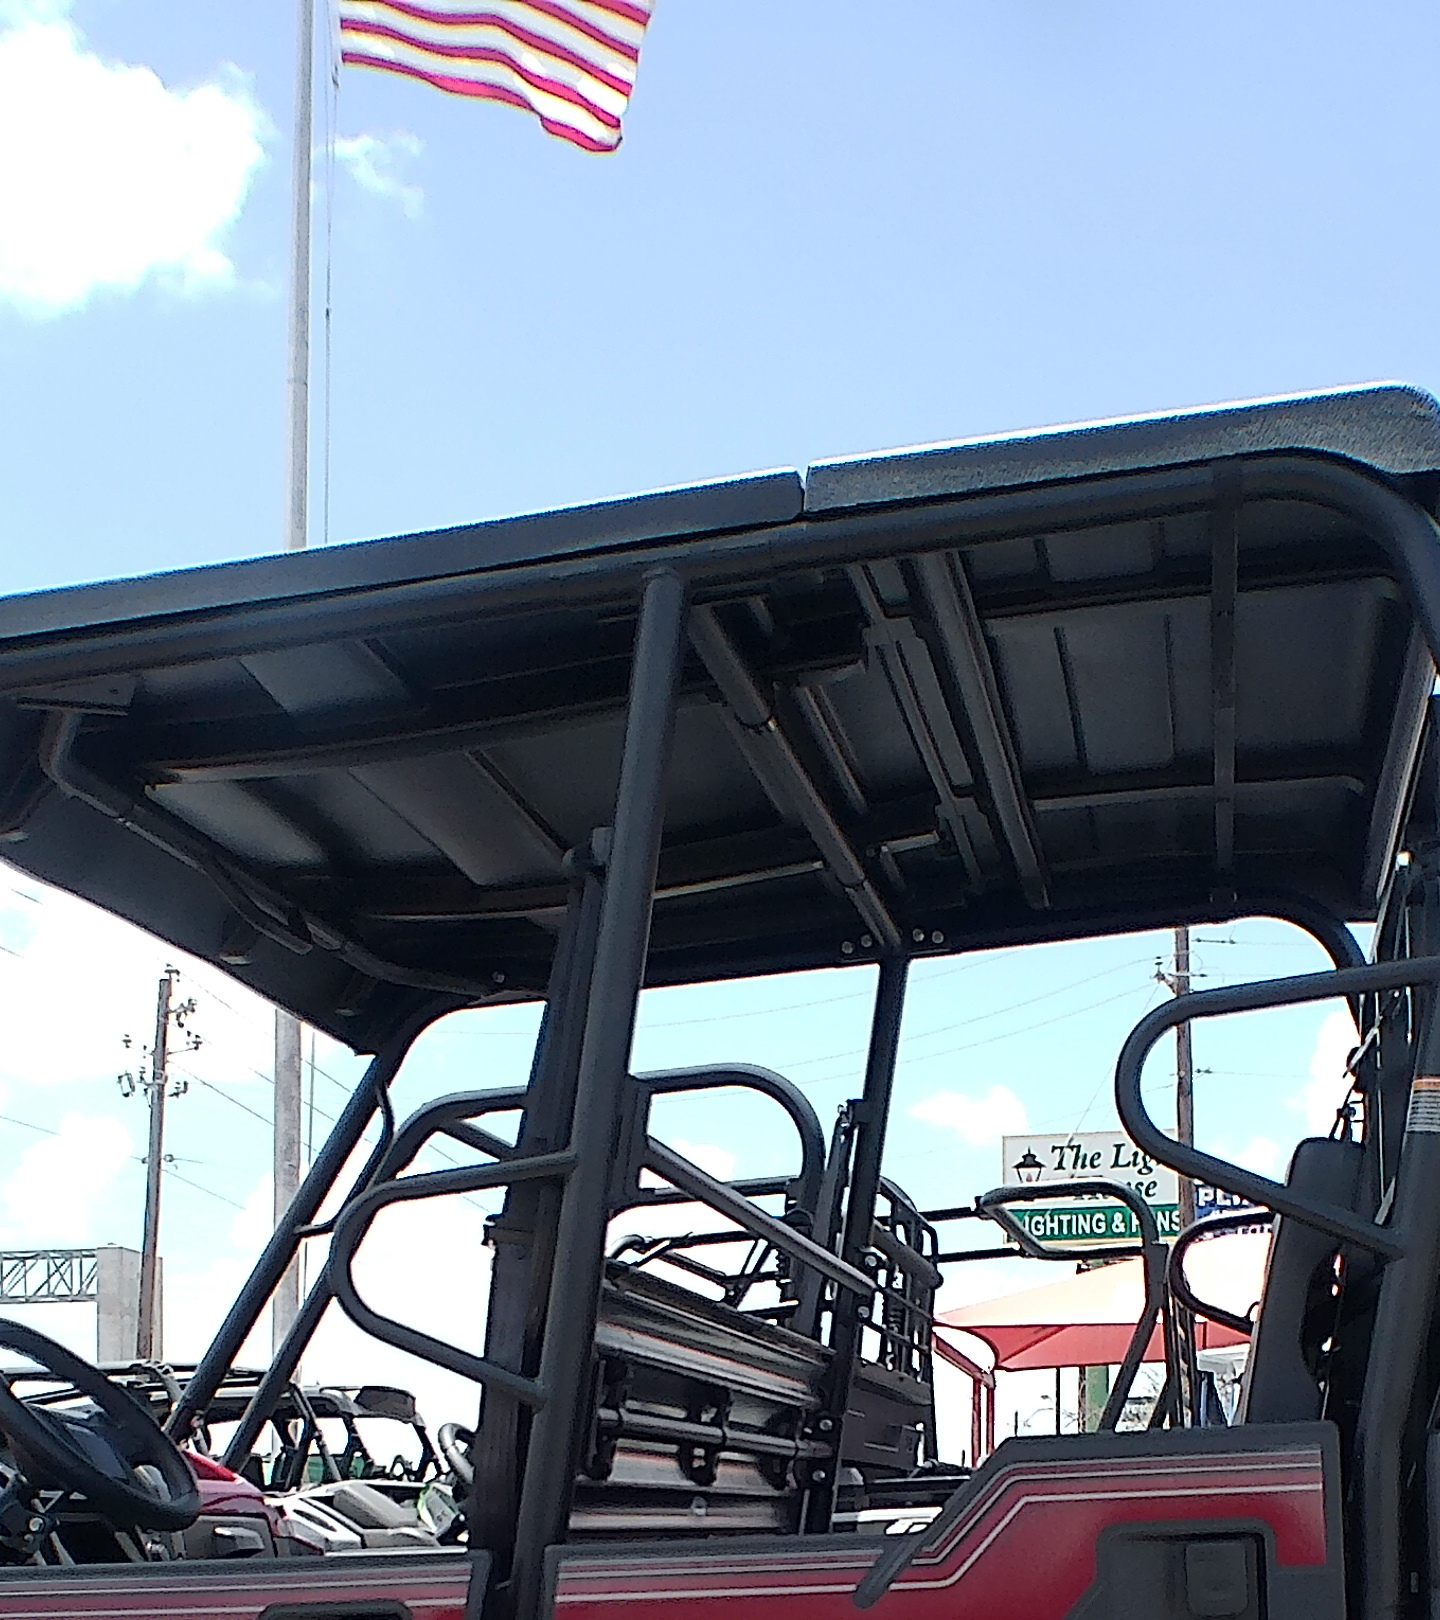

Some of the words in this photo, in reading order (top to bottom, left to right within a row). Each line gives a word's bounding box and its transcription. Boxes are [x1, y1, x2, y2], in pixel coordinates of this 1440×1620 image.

[1050, 1142, 1102, 1171] The
[1110, 1142, 1162, 1175] Lig
[1023, 1212, 1106, 1237] IGHTING
[1111, 1211, 1126, 1234] &
[1131, 1210, 1180, 1233] FNS
